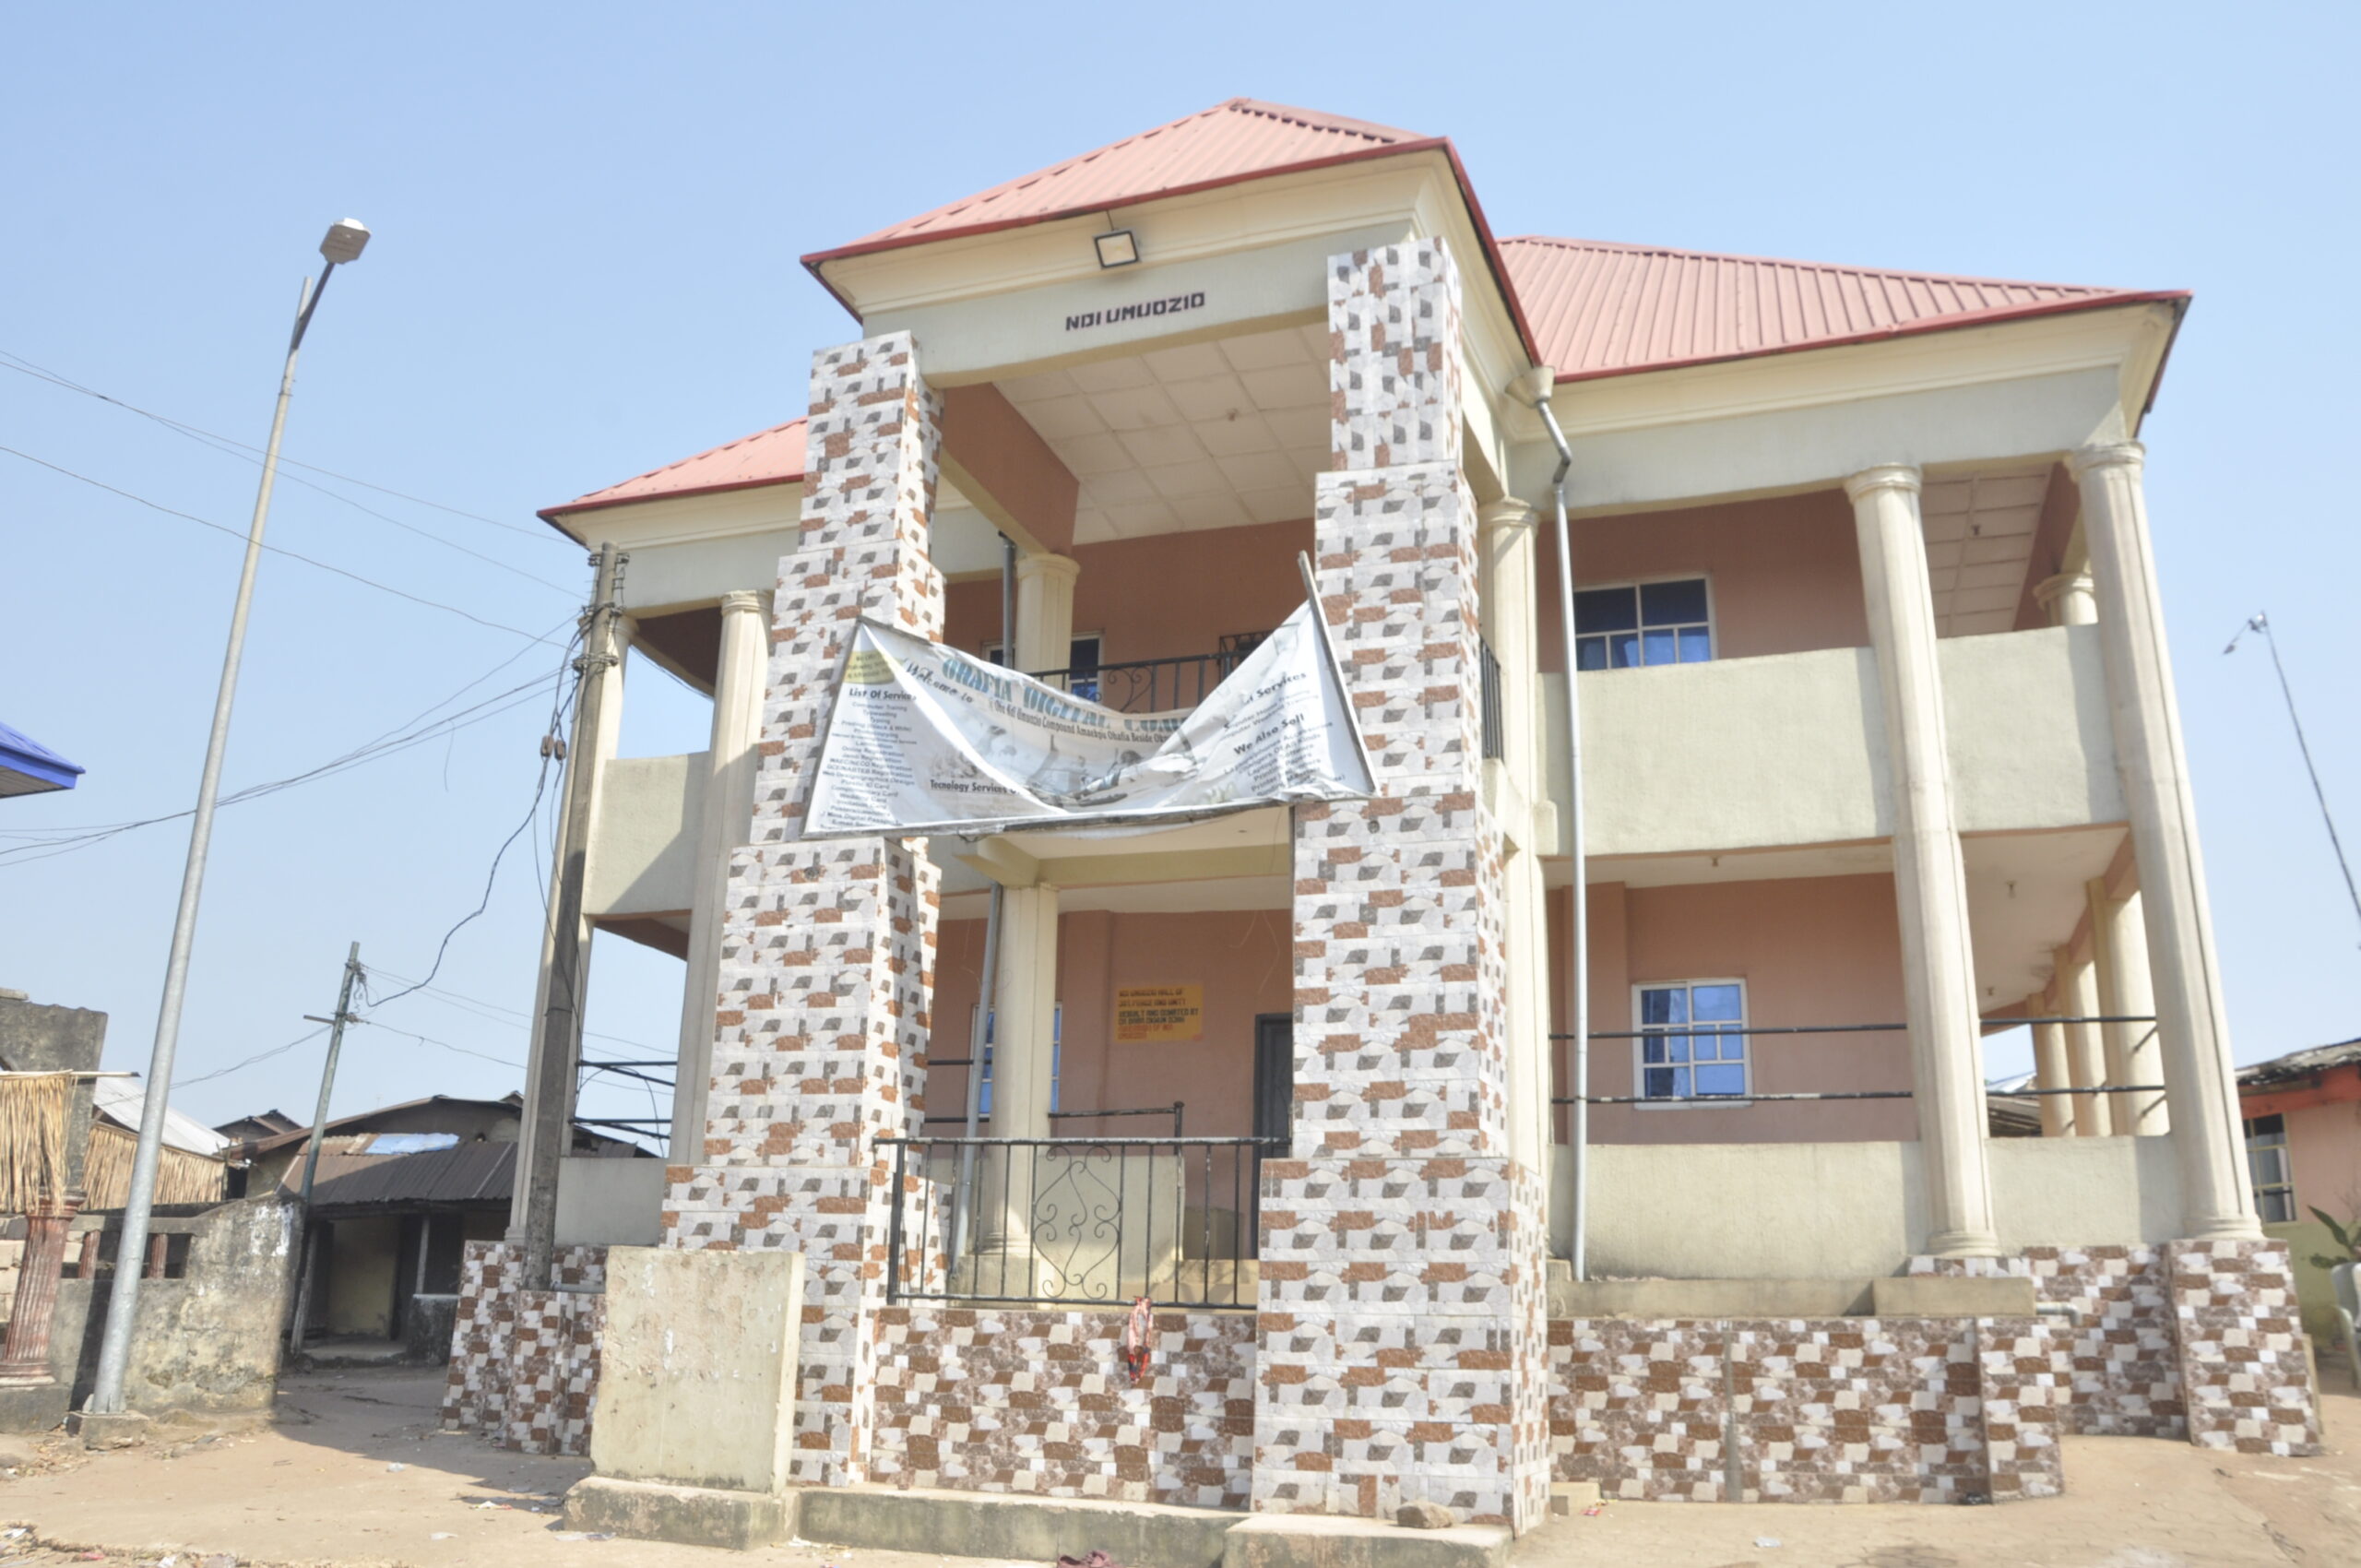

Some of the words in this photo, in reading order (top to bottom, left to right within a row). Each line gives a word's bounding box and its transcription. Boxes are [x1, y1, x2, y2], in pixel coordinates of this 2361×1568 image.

[1066, 311, 1101, 331] NDI
[1107, 292, 1205, 324] UMUOZIO
[849, 687, 867, 697] List
[870, 690, 881, 698] Of
[943, 659, 1013, 702] OHAFIA
[1024, 686, 1110, 729] DIGITAL
[1255, 671, 1307, 698] Services
[1043, 714, 1075, 734] Compound
[1107, 730, 1130, 742] Ohafia
[1233, 740, 1253, 755] We
[1255, 727, 1279, 744] Also
[1281, 713, 1305, 727] Sell
[930, 779, 969, 793] Tecnology
[971, 781, 1008, 794] Services
